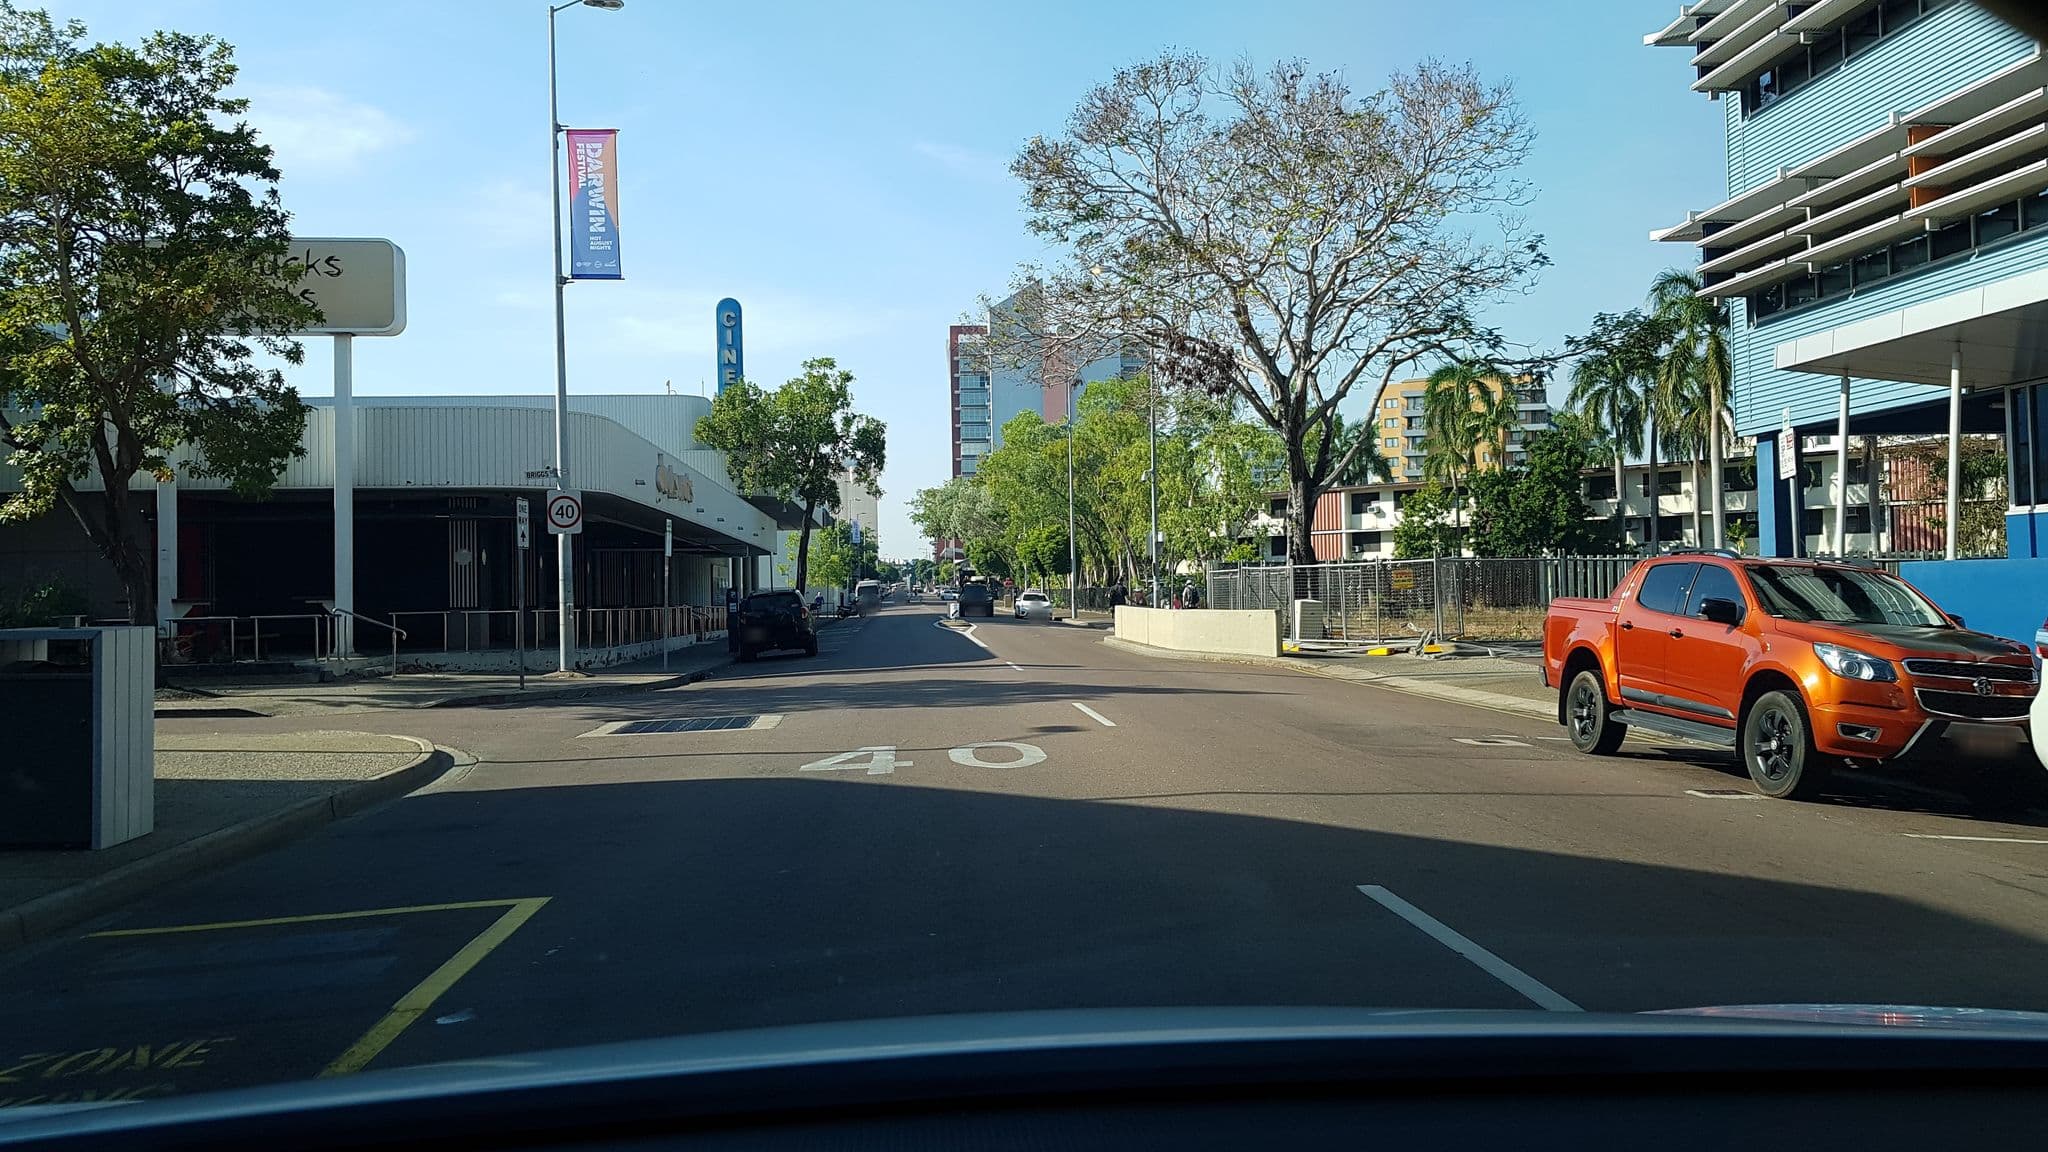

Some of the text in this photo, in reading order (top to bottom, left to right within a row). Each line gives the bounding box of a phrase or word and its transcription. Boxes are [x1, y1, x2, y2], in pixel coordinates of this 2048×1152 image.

[576, 143, 587, 189] FESTIVAL
[585, 142, 606, 233] DARWIN
[526, 470, 550, 479] BRIGGS
[518, 503, 528, 514] ONE
[555, 504, 575, 519] 40
